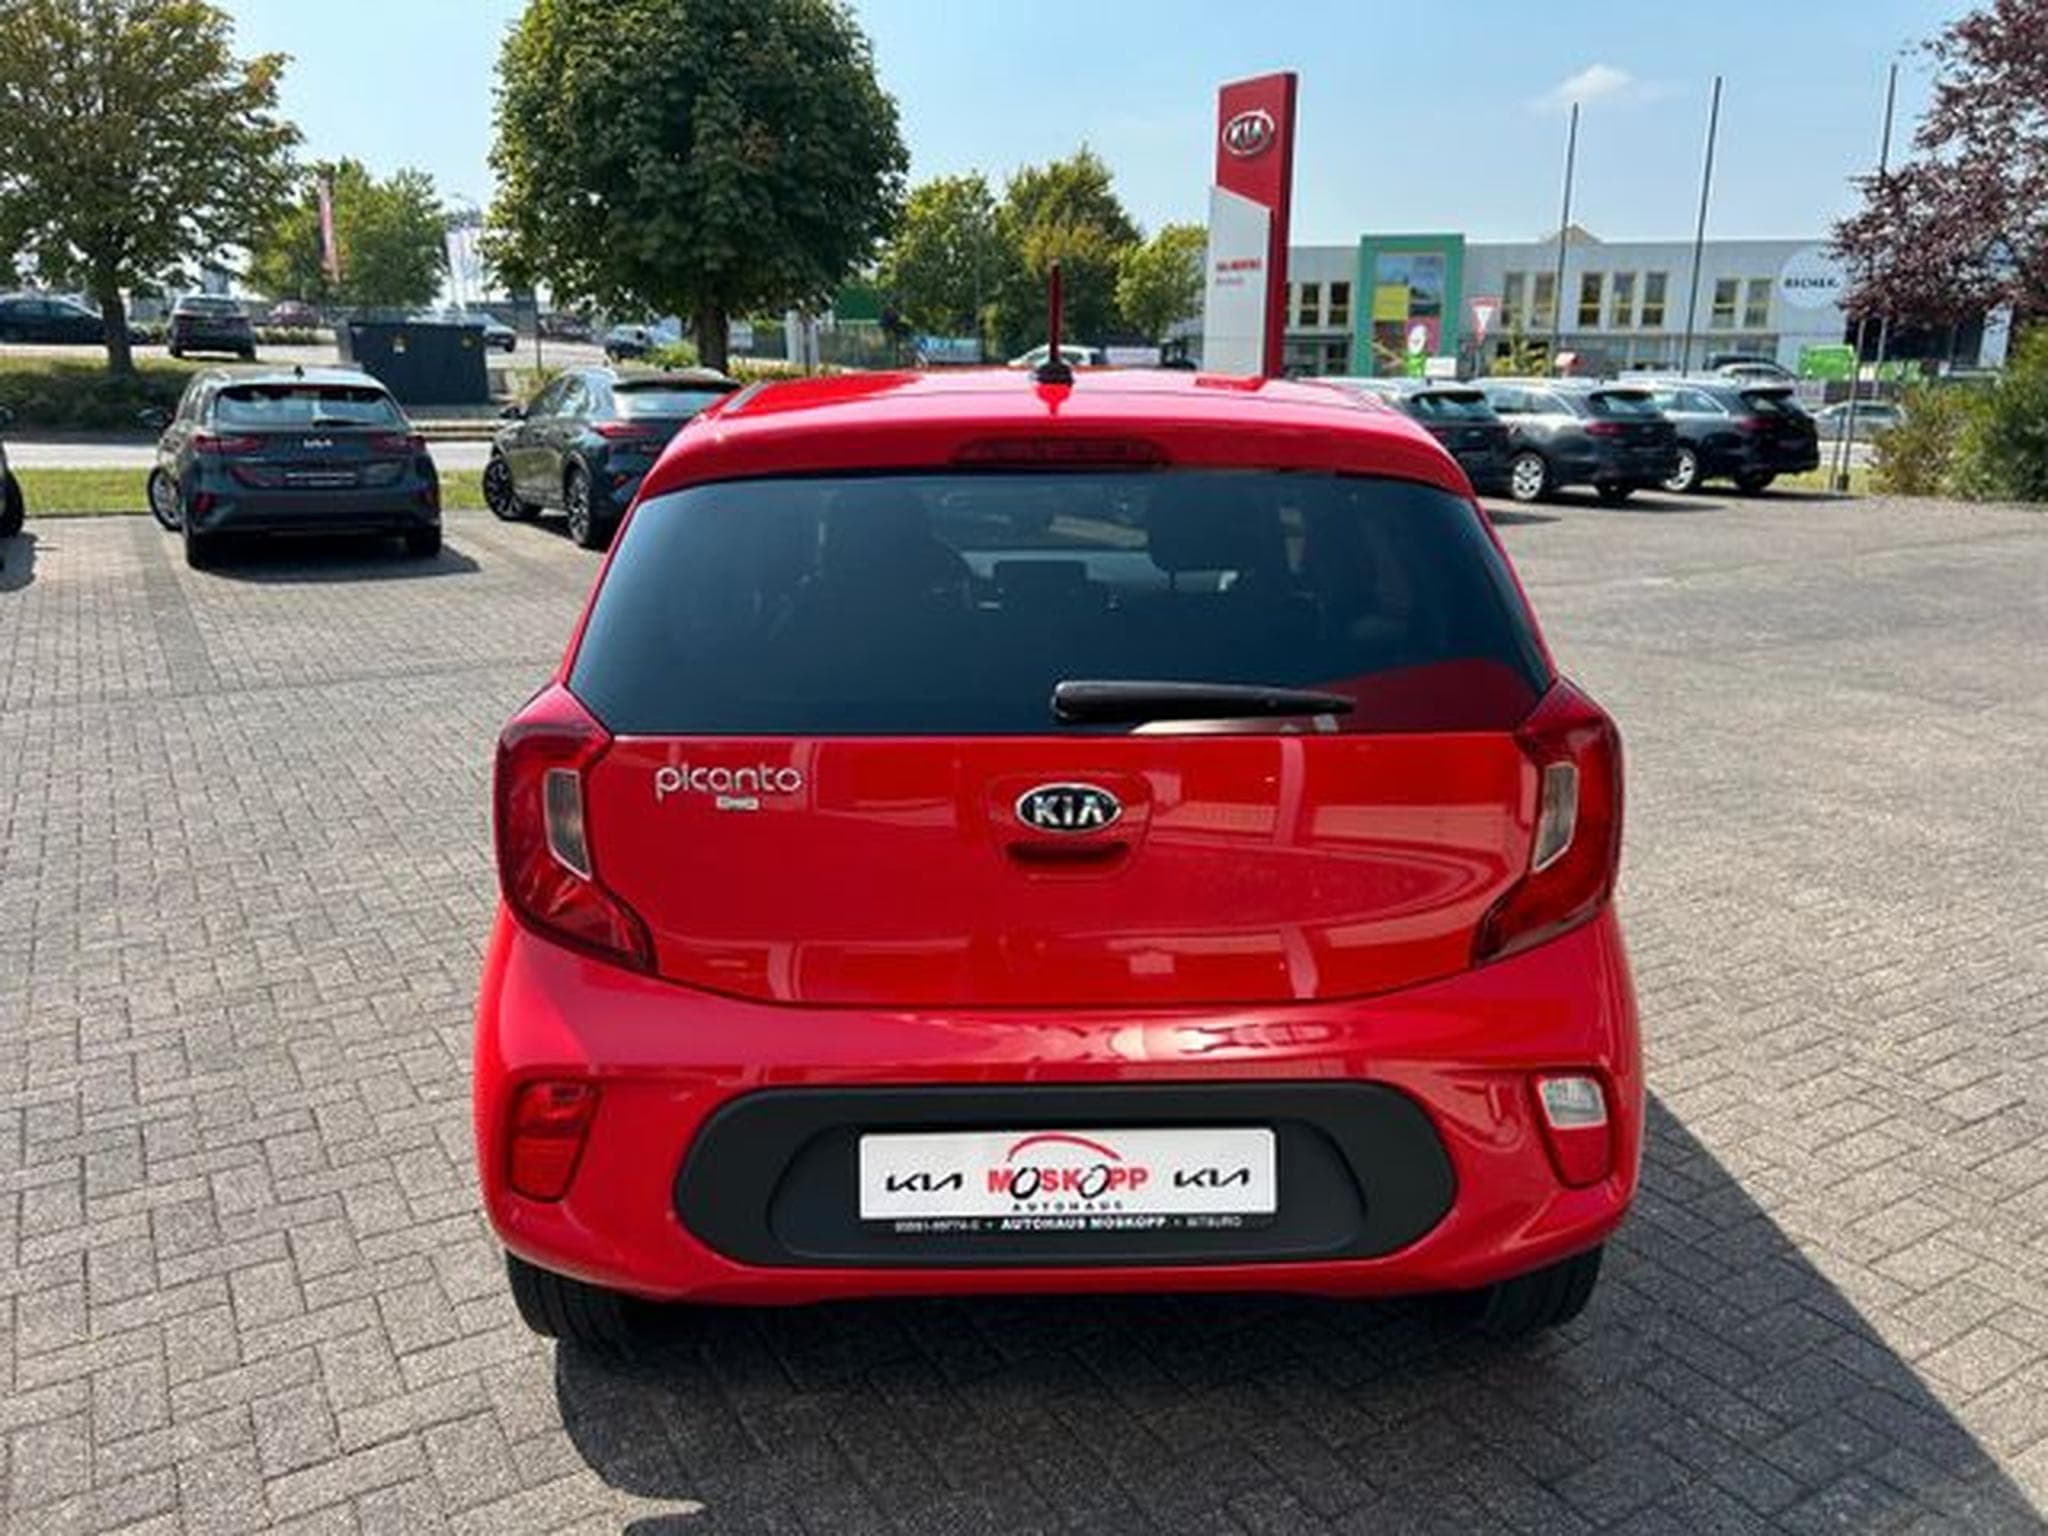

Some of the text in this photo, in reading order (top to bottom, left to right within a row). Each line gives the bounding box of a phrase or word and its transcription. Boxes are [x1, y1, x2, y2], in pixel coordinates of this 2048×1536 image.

[1230, 118, 1265, 149] KIA
[655, 763, 802, 803] picanto
[1031, 794, 1105, 826] KIA
[886, 1164, 1251, 1200] KIA MOSKOPP KIA
[1012, 1201, 1124, 1212] AUTOHAUS
[1000, 1216, 1086, 1231] AUTOHAUS
[1090, 1215, 1167, 1229] MOSKOPP
